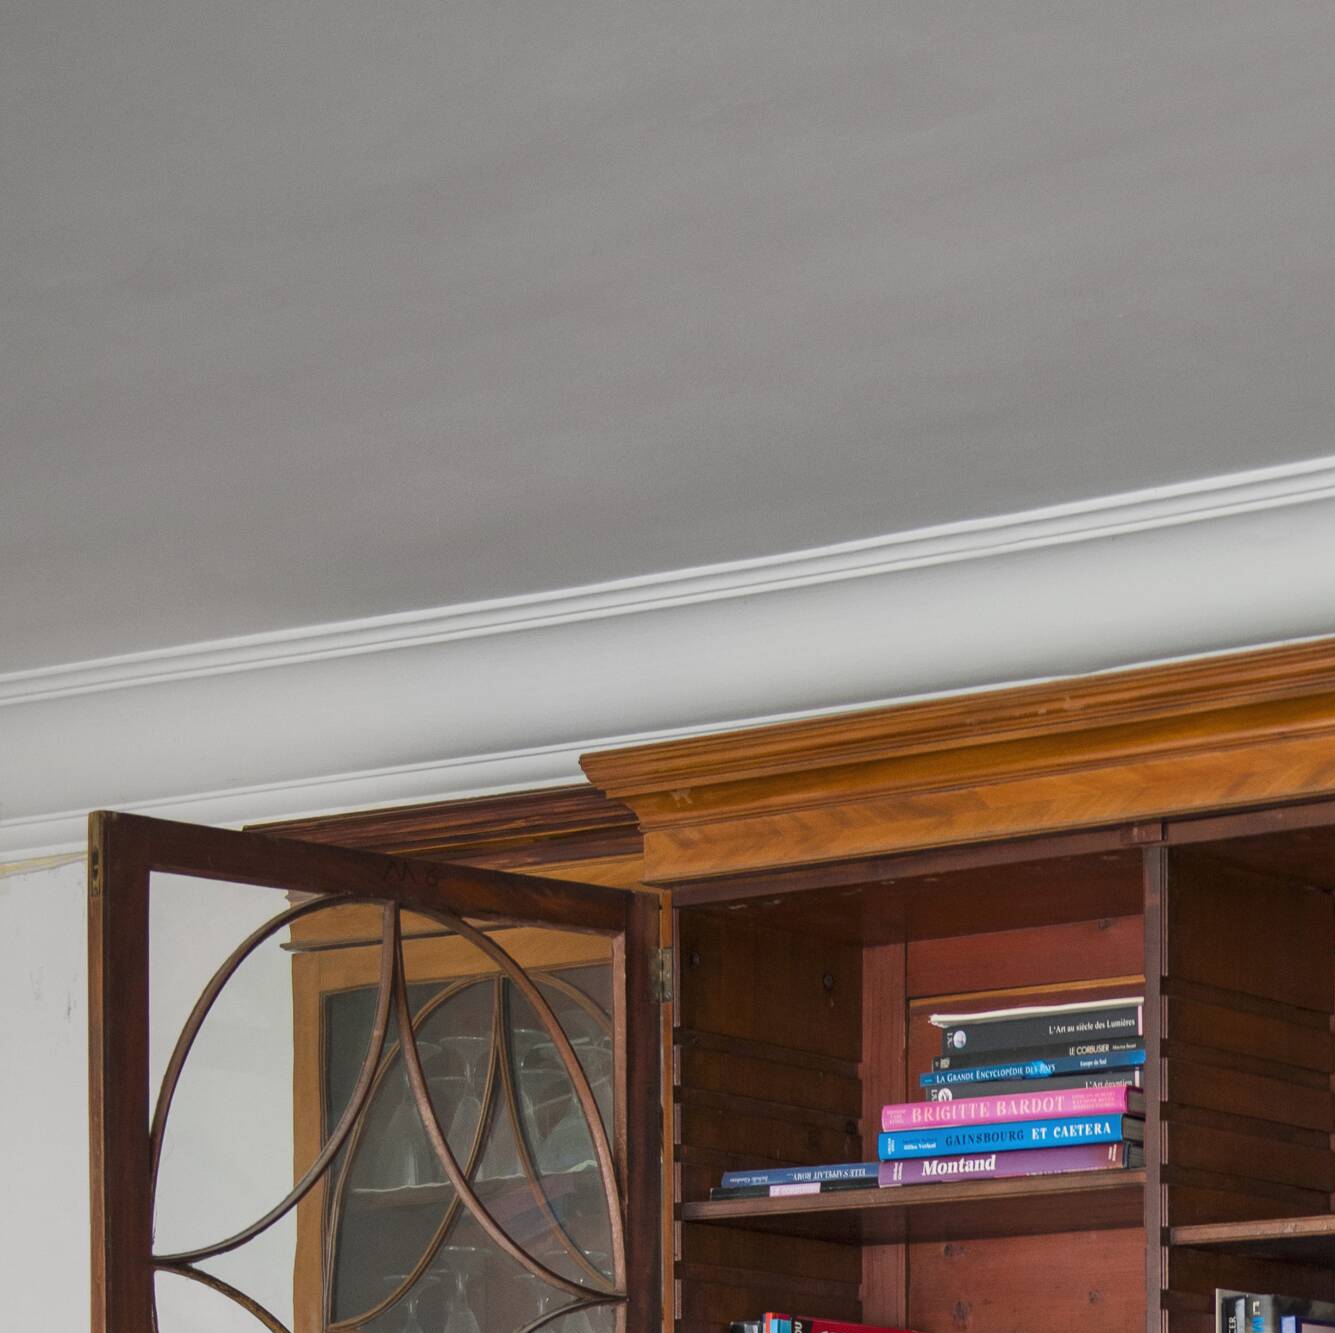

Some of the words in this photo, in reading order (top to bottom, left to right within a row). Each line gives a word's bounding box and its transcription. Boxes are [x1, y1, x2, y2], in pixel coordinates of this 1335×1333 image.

[1048, 1025, 1066, 1035] L'Art
[1076, 1043, 1110, 1055] CORBUSIER
[912, 1102, 990, 1124] BRIGITTE
[996, 1096, 1065, 1117] BARDOT
[946, 1130, 1024, 1146] GAINSBOURG
[1032, 1127, 1048, 1140] ET
[1053, 1122, 1112, 1138] CAETERA
[921, 1154, 996, 1177] Montand
